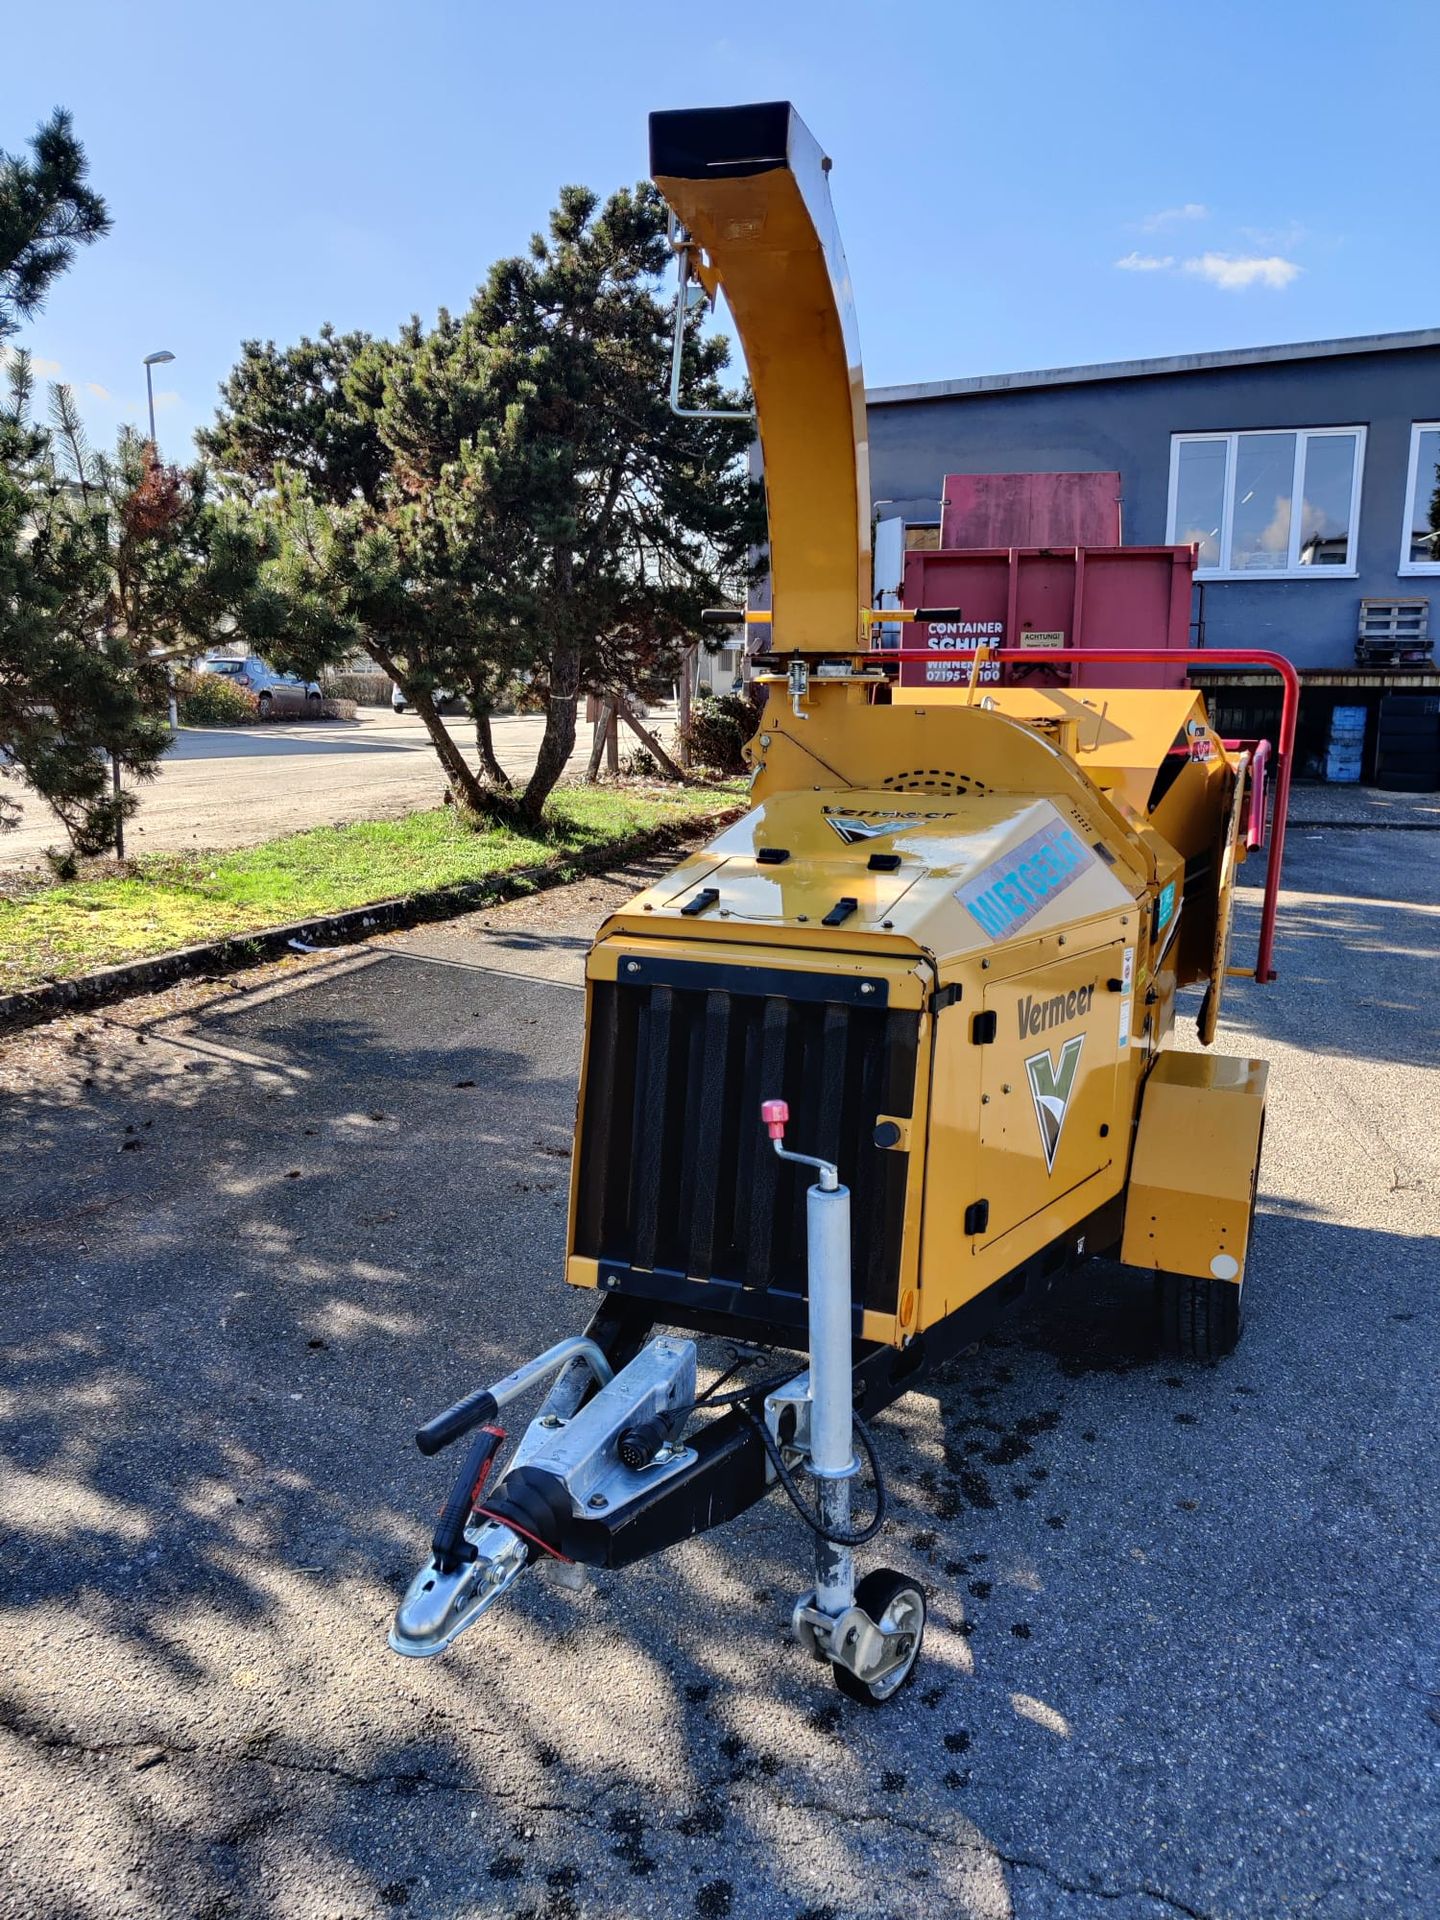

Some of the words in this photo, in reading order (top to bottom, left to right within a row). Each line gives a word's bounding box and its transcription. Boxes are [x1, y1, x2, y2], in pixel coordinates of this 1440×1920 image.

[928, 622, 1003, 634] CONTAINER
[1024, 632, 1060, 641] ACHTUNG!
[926, 670, 1000, 681] 07195-9100
[1017, 983, 1095, 1040] Vermeer
